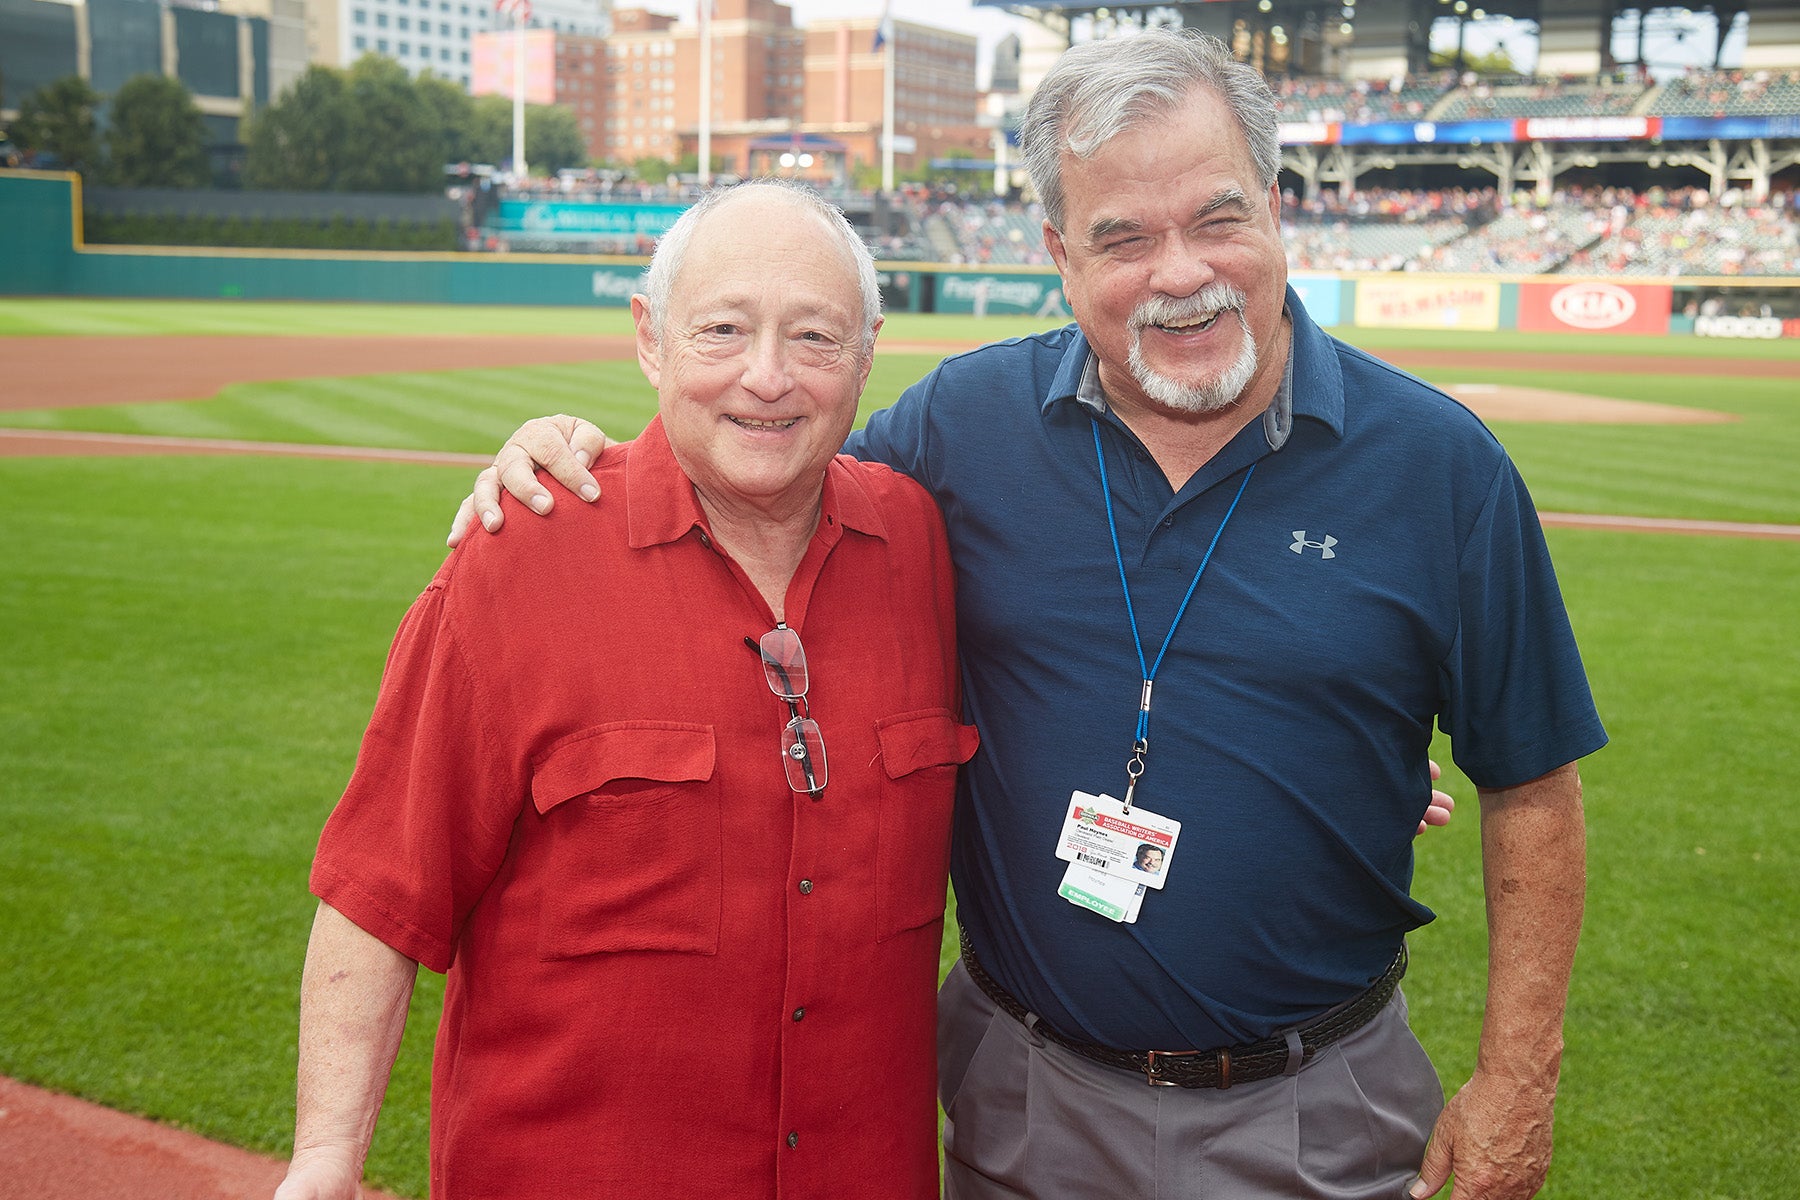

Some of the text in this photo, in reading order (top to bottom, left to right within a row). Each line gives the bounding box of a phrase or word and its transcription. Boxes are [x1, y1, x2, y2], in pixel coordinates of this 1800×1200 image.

[1564, 291, 1623, 317] KIA
[1102, 822, 1137, 837] ASSOCIATION
[1145, 836, 1169, 847] AMERICA
[1103, 816, 1131, 829] BASEBALL
[1066, 842, 1088, 853] 2018
[1068, 889, 1116, 914] EMPLOYEE
